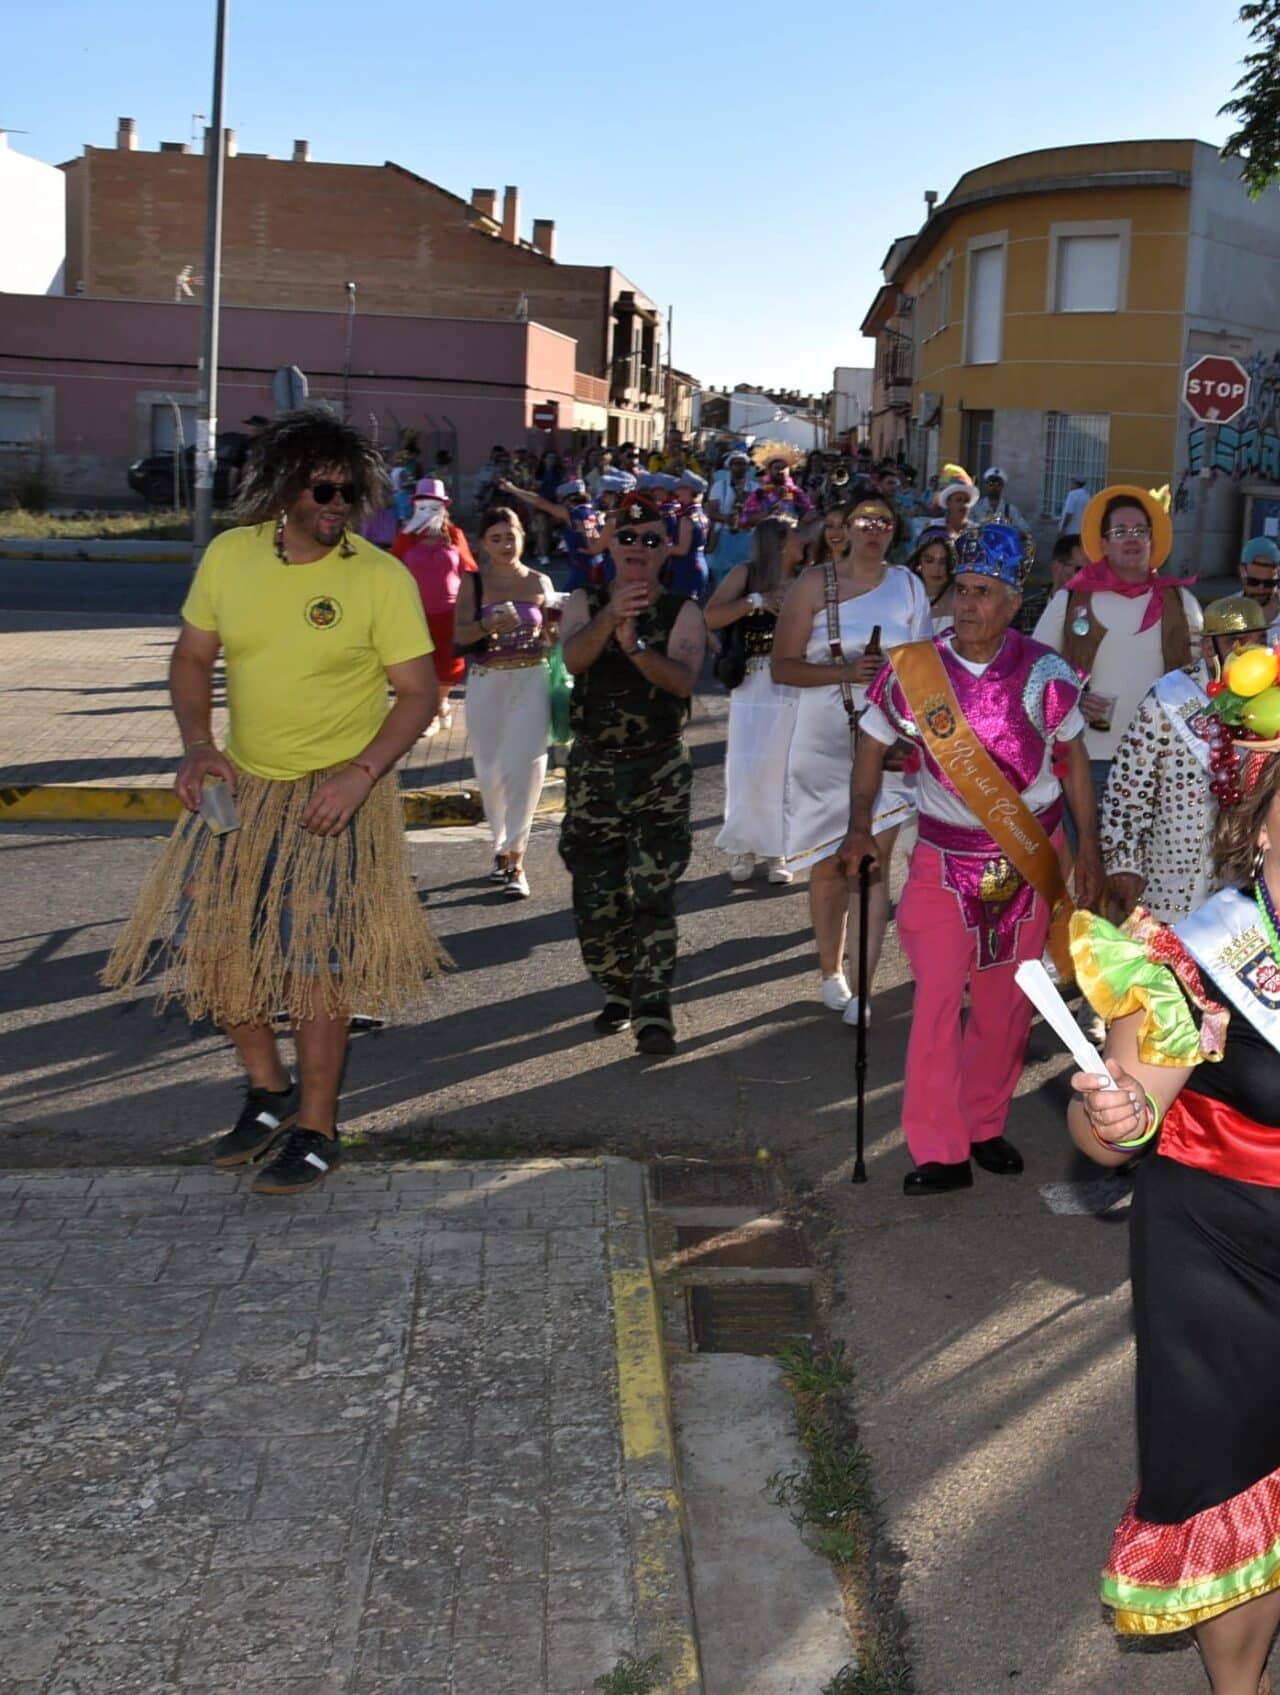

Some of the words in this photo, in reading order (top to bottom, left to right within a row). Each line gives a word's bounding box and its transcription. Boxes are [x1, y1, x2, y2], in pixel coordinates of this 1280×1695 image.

[1188, 379, 1245, 399] STOP
[942, 740, 977, 777] Rey
[975, 777, 999, 796] del
[988, 797, 1040, 855] Carnaval
